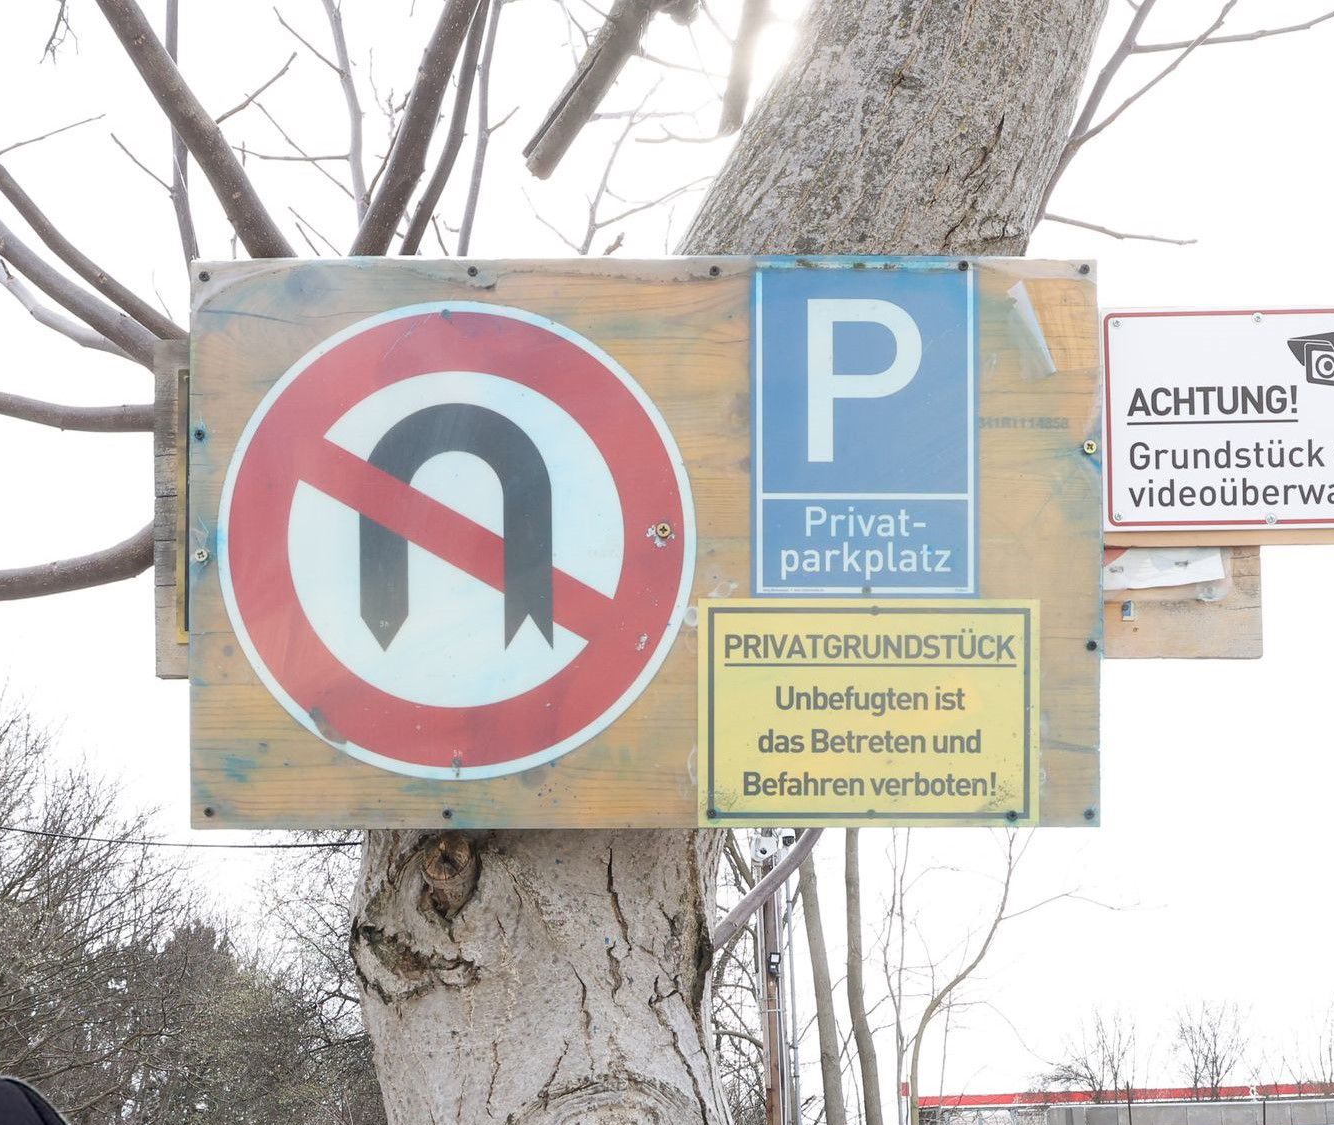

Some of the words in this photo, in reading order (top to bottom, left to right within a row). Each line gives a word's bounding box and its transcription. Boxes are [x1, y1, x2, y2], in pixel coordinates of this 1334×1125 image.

[806, 297, 923, 464] P
[1126, 384, 1299, 417] ACHTUNG!
[1128, 439, 1325, 471] Grundstück
[804, 505, 928, 538] Privat-
[779, 543, 952, 582] parkplatz
[724, 628, 1016, 660] PRIVATGRUNDSTÜCK
[774, 685, 929, 717] Unbefugten
[934, 686, 966, 713] ist
[756, 729, 805, 755] das
[811, 729, 927, 755] Betreten
[932, 728, 983, 754] und
[742, 771, 865, 799] Befahren
[870, 771, 998, 798] verboten!
